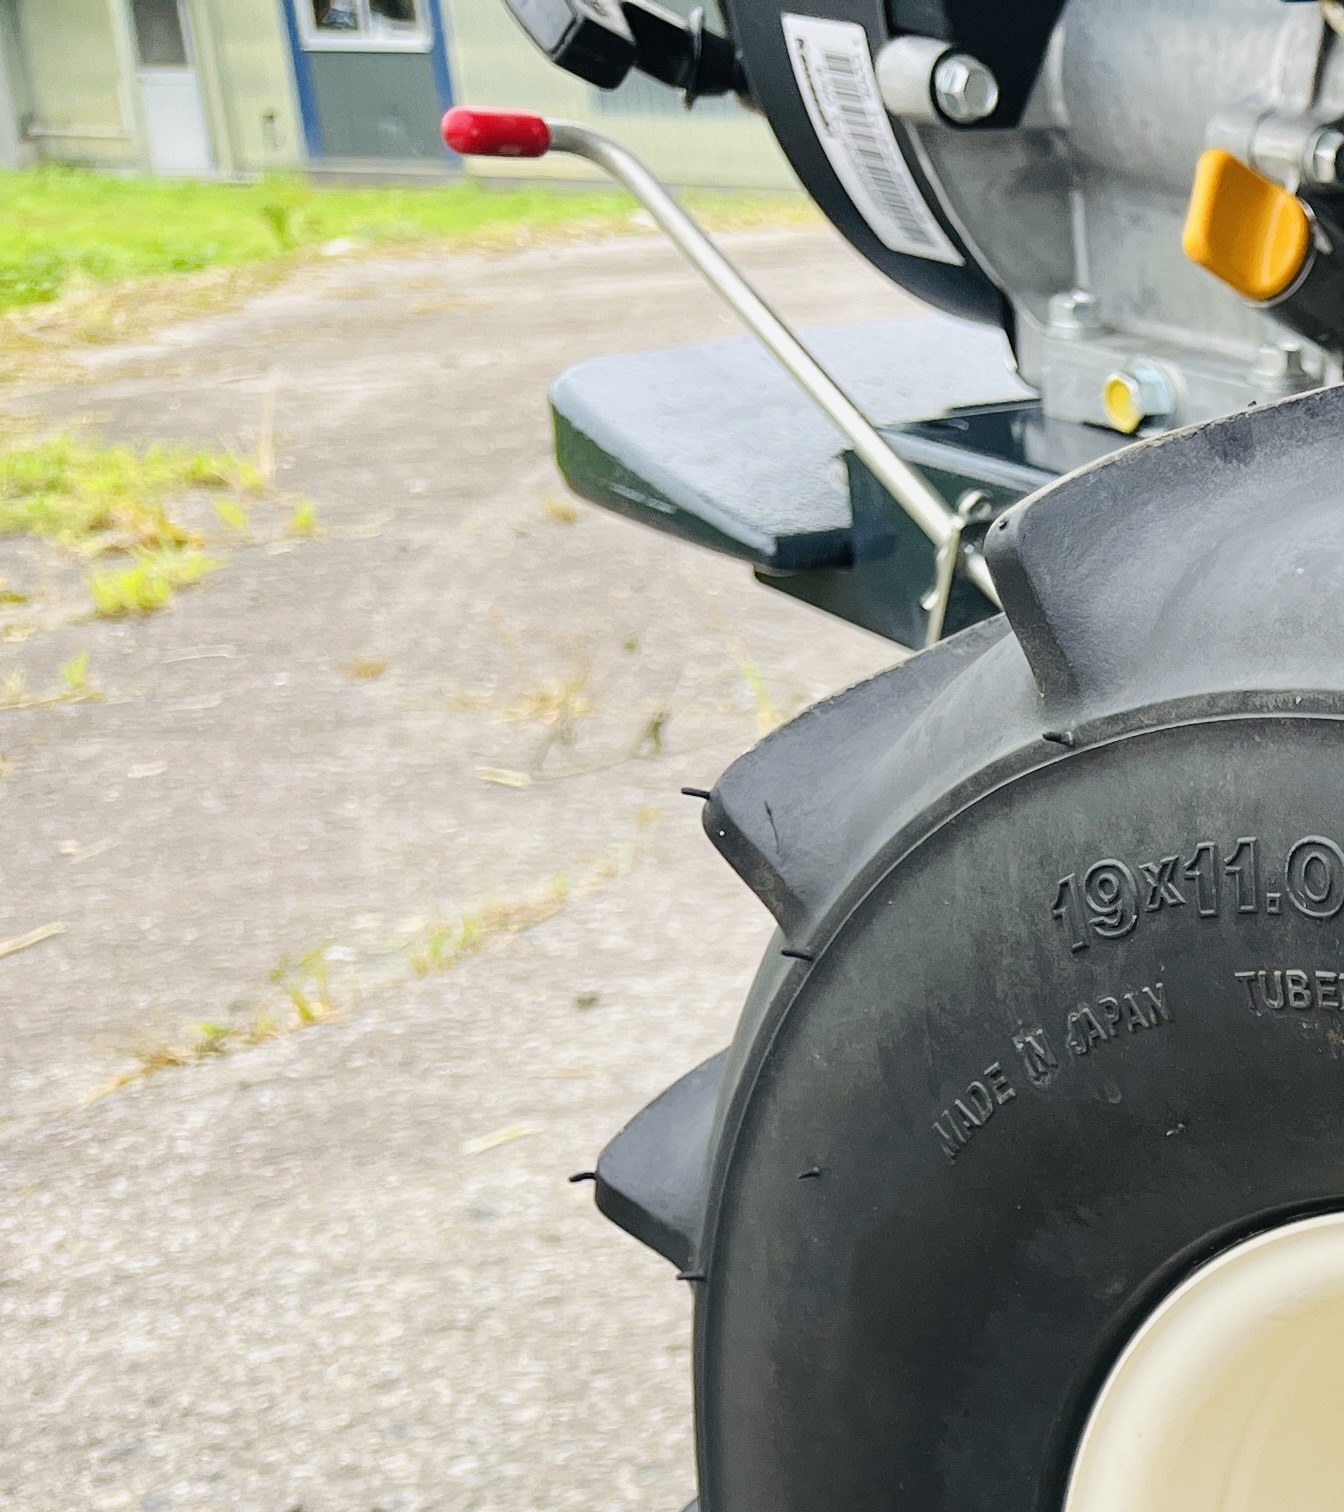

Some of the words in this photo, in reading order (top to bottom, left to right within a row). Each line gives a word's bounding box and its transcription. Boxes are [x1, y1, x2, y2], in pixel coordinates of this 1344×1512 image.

[930, 1060, 1018, 1163] MADE
[1012, 1028, 1060, 1085] IN
[1065, 982, 1175, 1056] JAPAN
